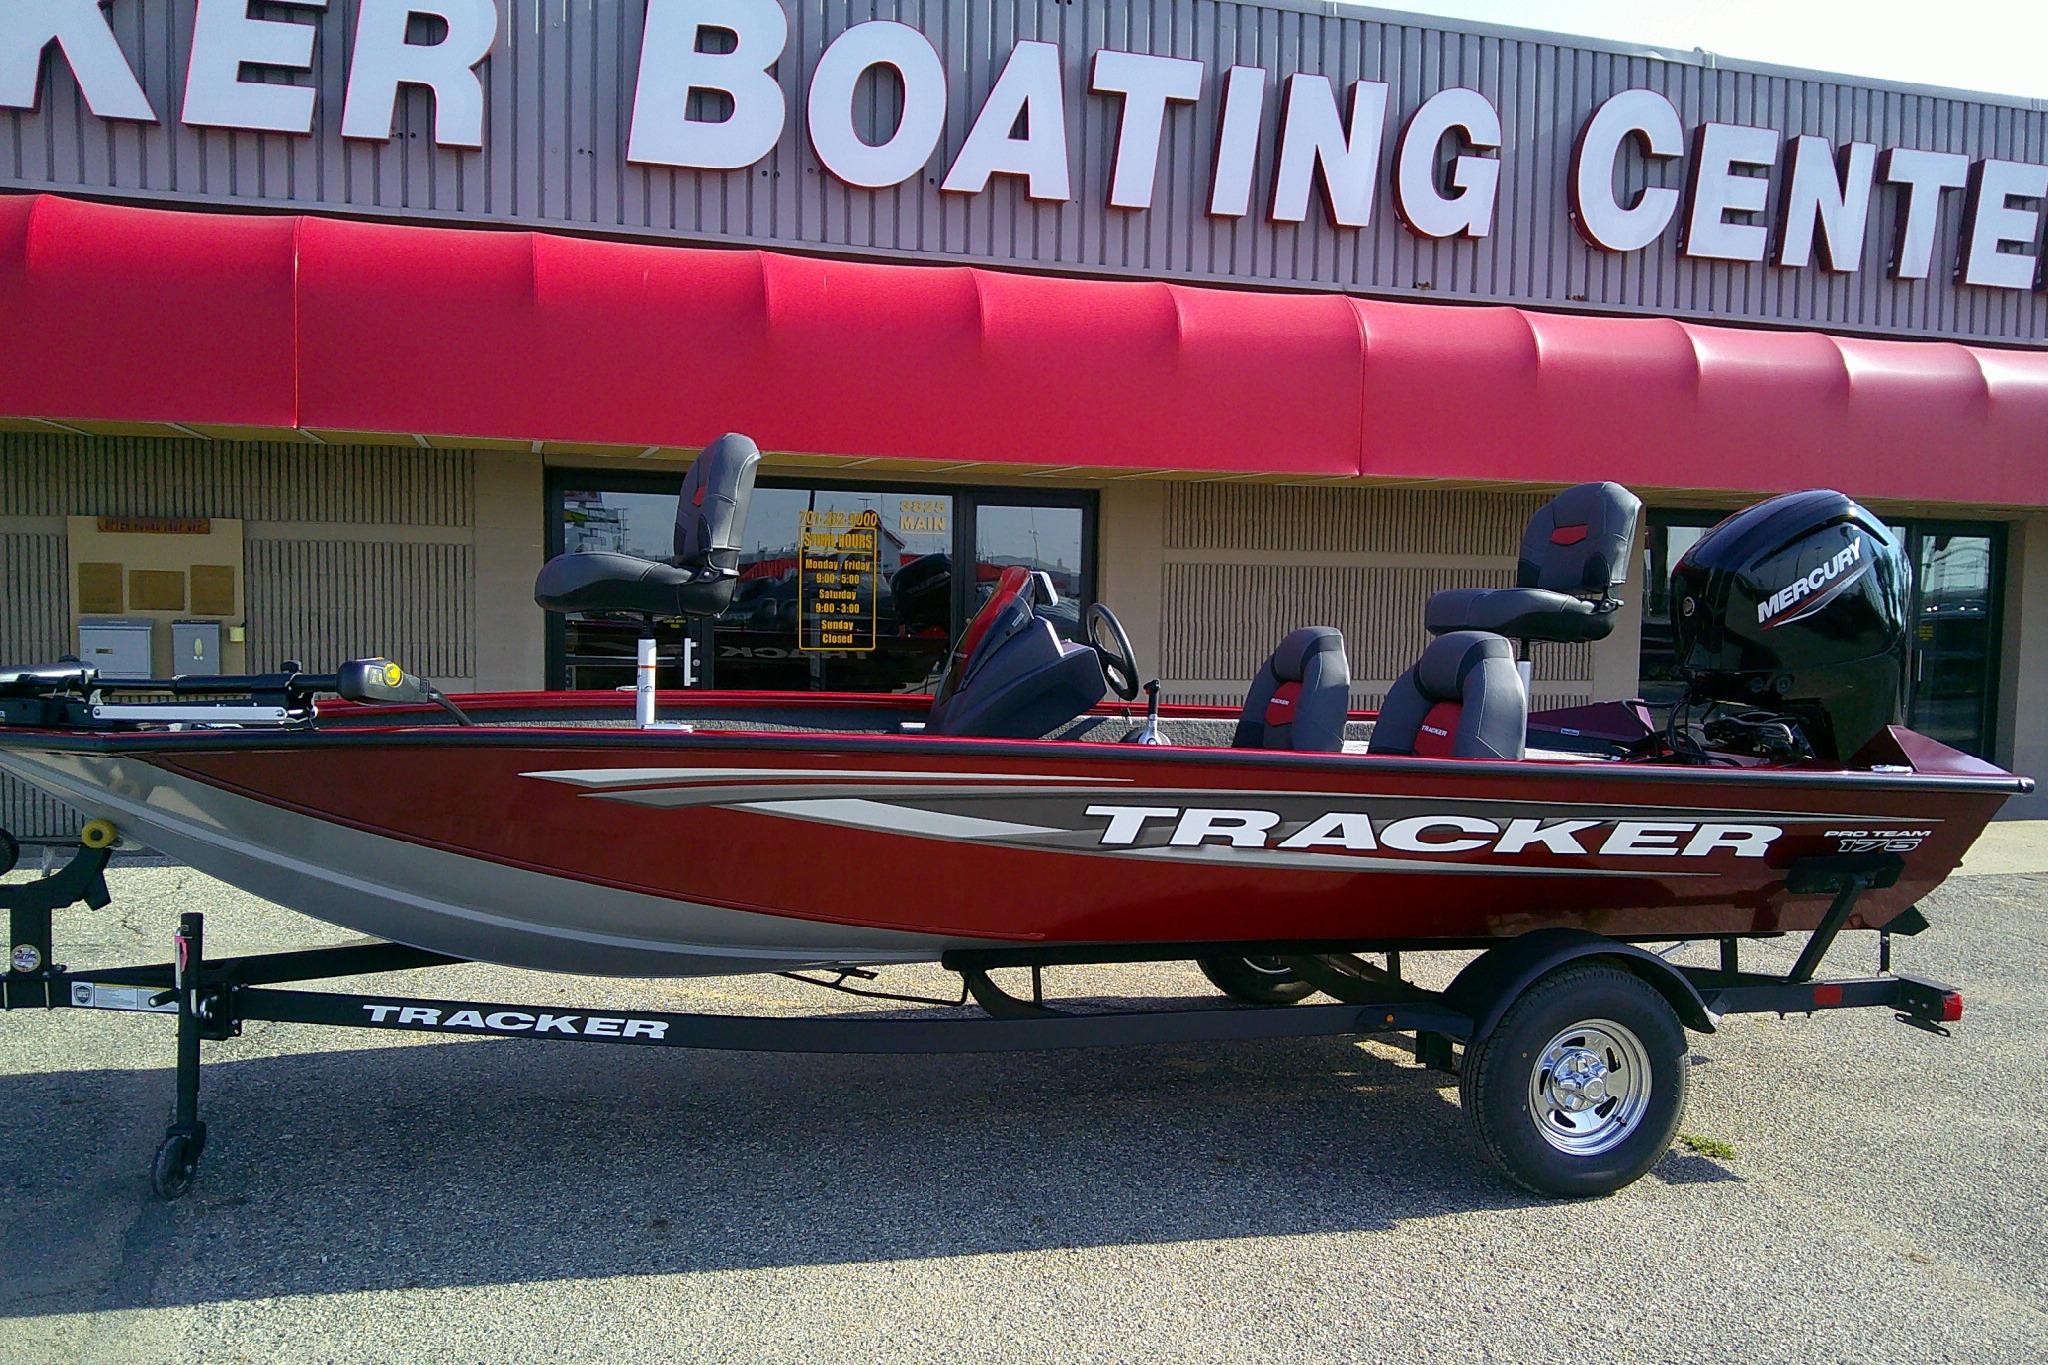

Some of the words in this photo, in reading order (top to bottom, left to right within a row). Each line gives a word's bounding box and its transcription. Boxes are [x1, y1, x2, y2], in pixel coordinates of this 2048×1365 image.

[626, 0, 1502, 240] BOATING
[1567, 87, 2048, 293] CENTE
[900, 514, 946, 531] MAIN
[838, 533, 873, 549] HOURS
[805, 559, 839, 570] Monday
[844, 560, 871, 572] Friday
[816, 573, 835, 584] 9:00
[841, 574, 860, 585] 5:00
[1757, 536, 1863, 624] MERCURY
[819, 589, 857, 601] Saturday
[815, 603, 835, 613] 9:00
[841, 603, 860, 614] 3:00
[821, 619, 854, 631] Sunday
[822, 633, 853, 644] Closed
[1421, 724, 1448, 737] TRACKER
[1084, 804, 1784, 861] TRACKER
[1824, 830, 1869, 838] PRO
[1837, 838, 1923, 853] 175
[362, 1003, 671, 1040] TRACKER
